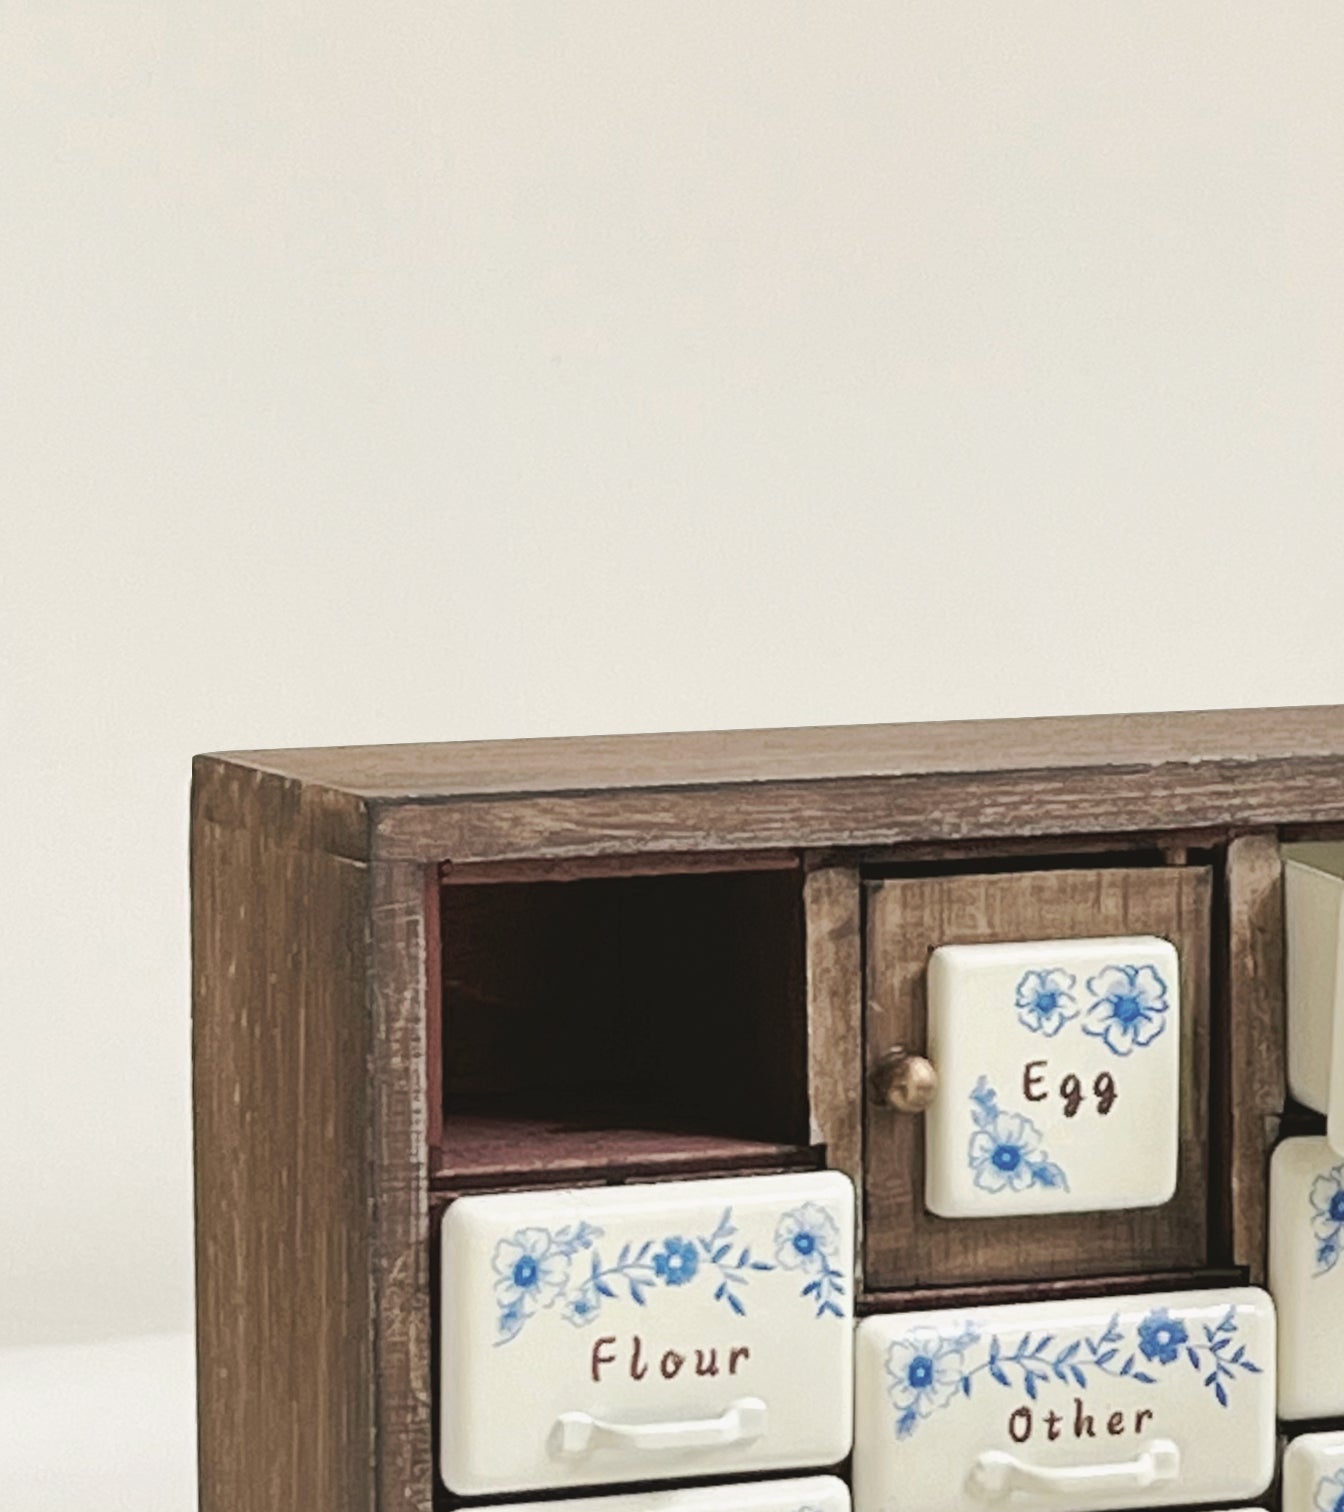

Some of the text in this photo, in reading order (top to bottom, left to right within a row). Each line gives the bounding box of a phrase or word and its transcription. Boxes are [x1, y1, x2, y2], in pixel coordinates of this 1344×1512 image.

[1022, 1059, 1119, 1120] Egg
[590, 1334, 751, 1383] Flour
[1007, 1396, 1154, 1445] Other
